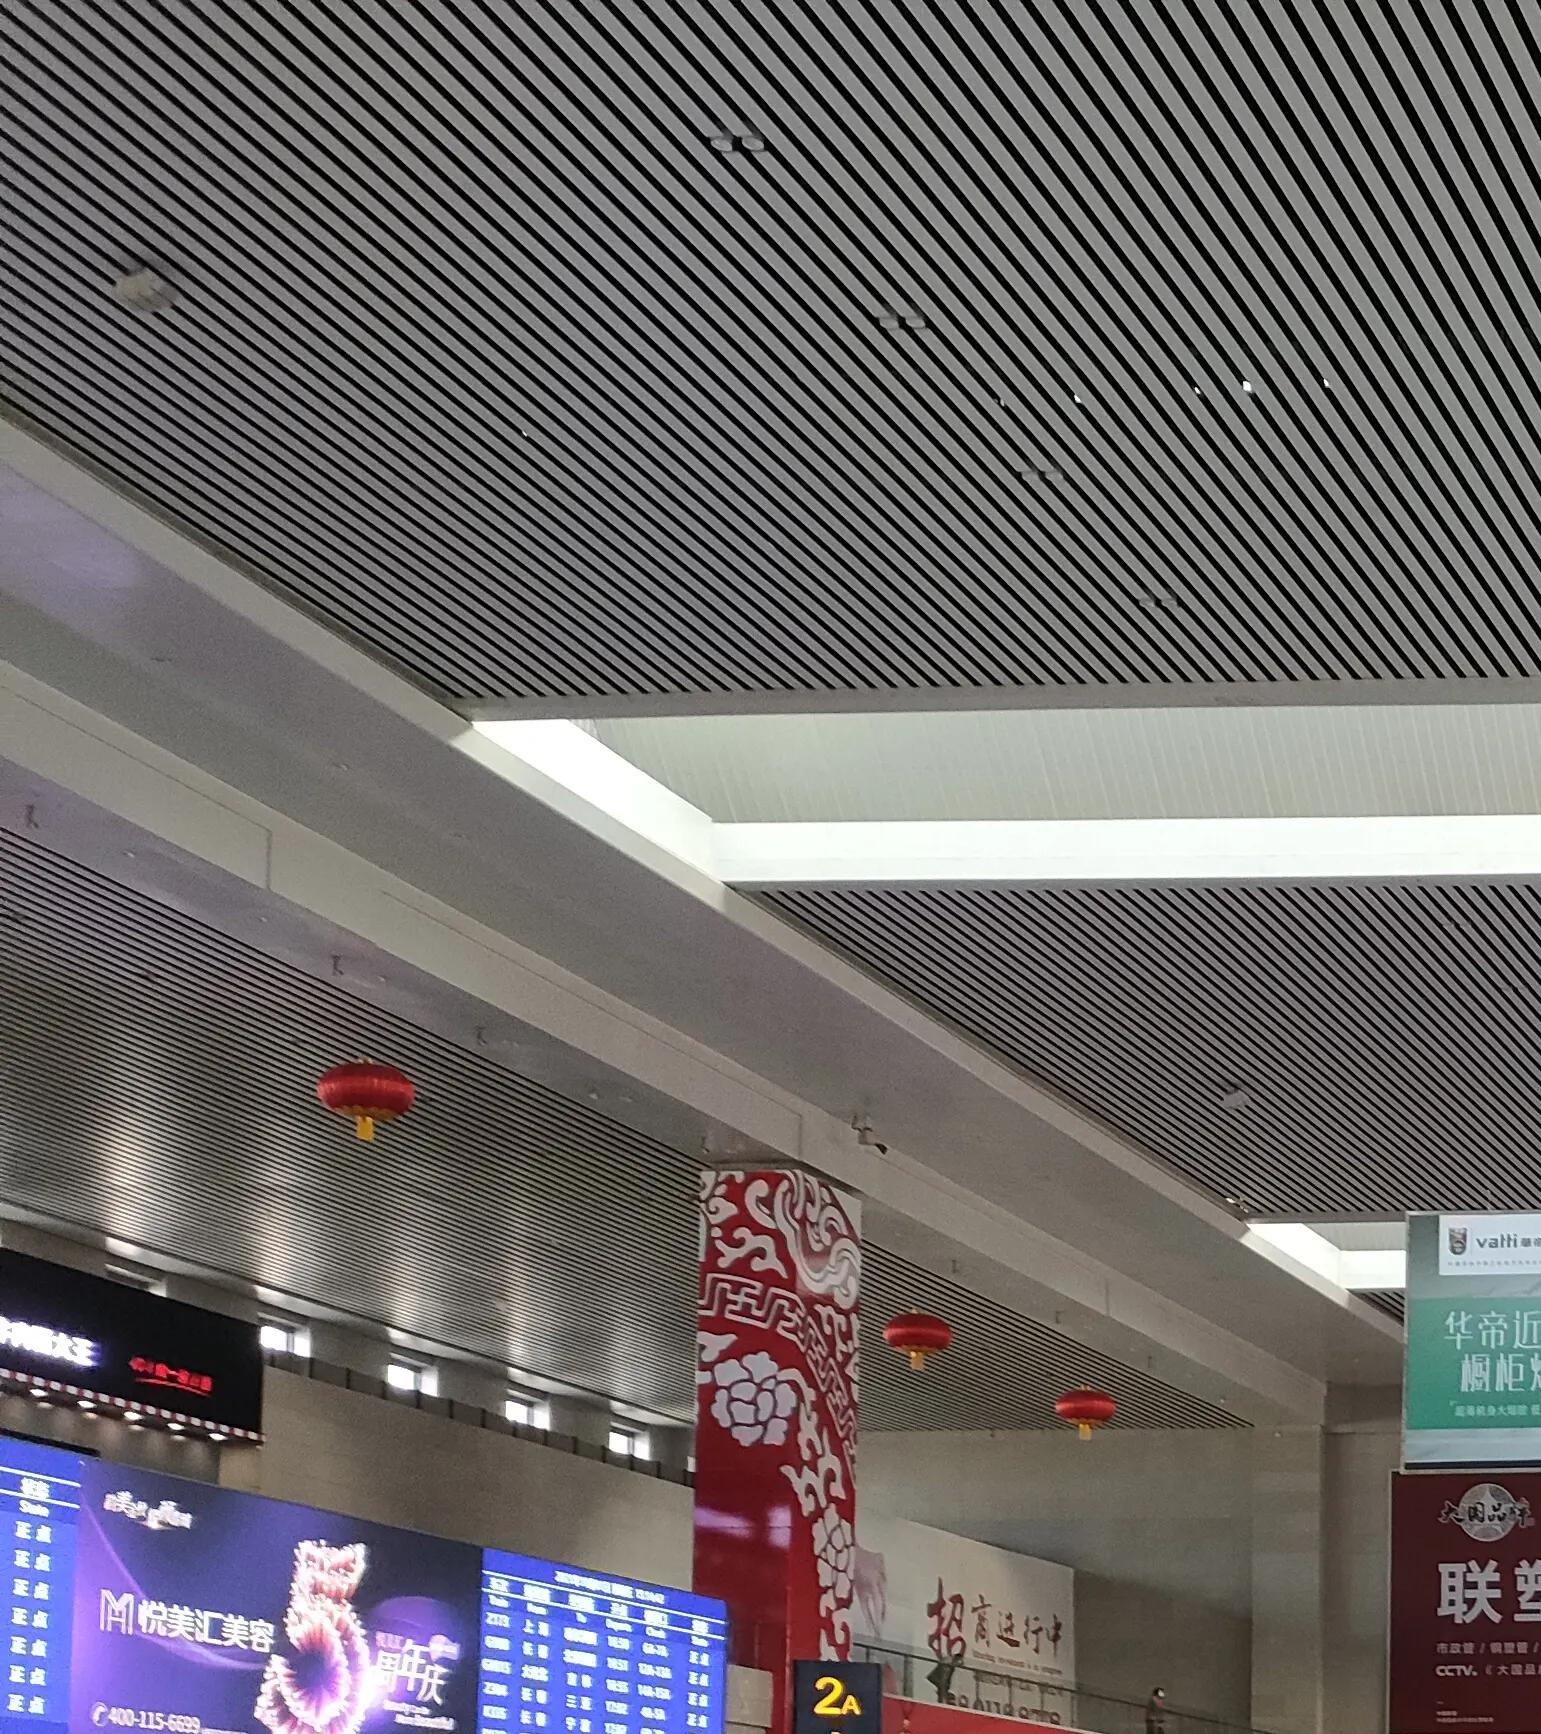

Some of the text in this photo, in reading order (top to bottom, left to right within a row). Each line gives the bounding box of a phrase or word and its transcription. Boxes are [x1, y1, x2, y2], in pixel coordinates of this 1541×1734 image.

[1475, 1233, 1518, 1249] vatti
[138, 1598, 275, 1654] 悦美汇美容
[813, 1675, 862, 1716] 2A
